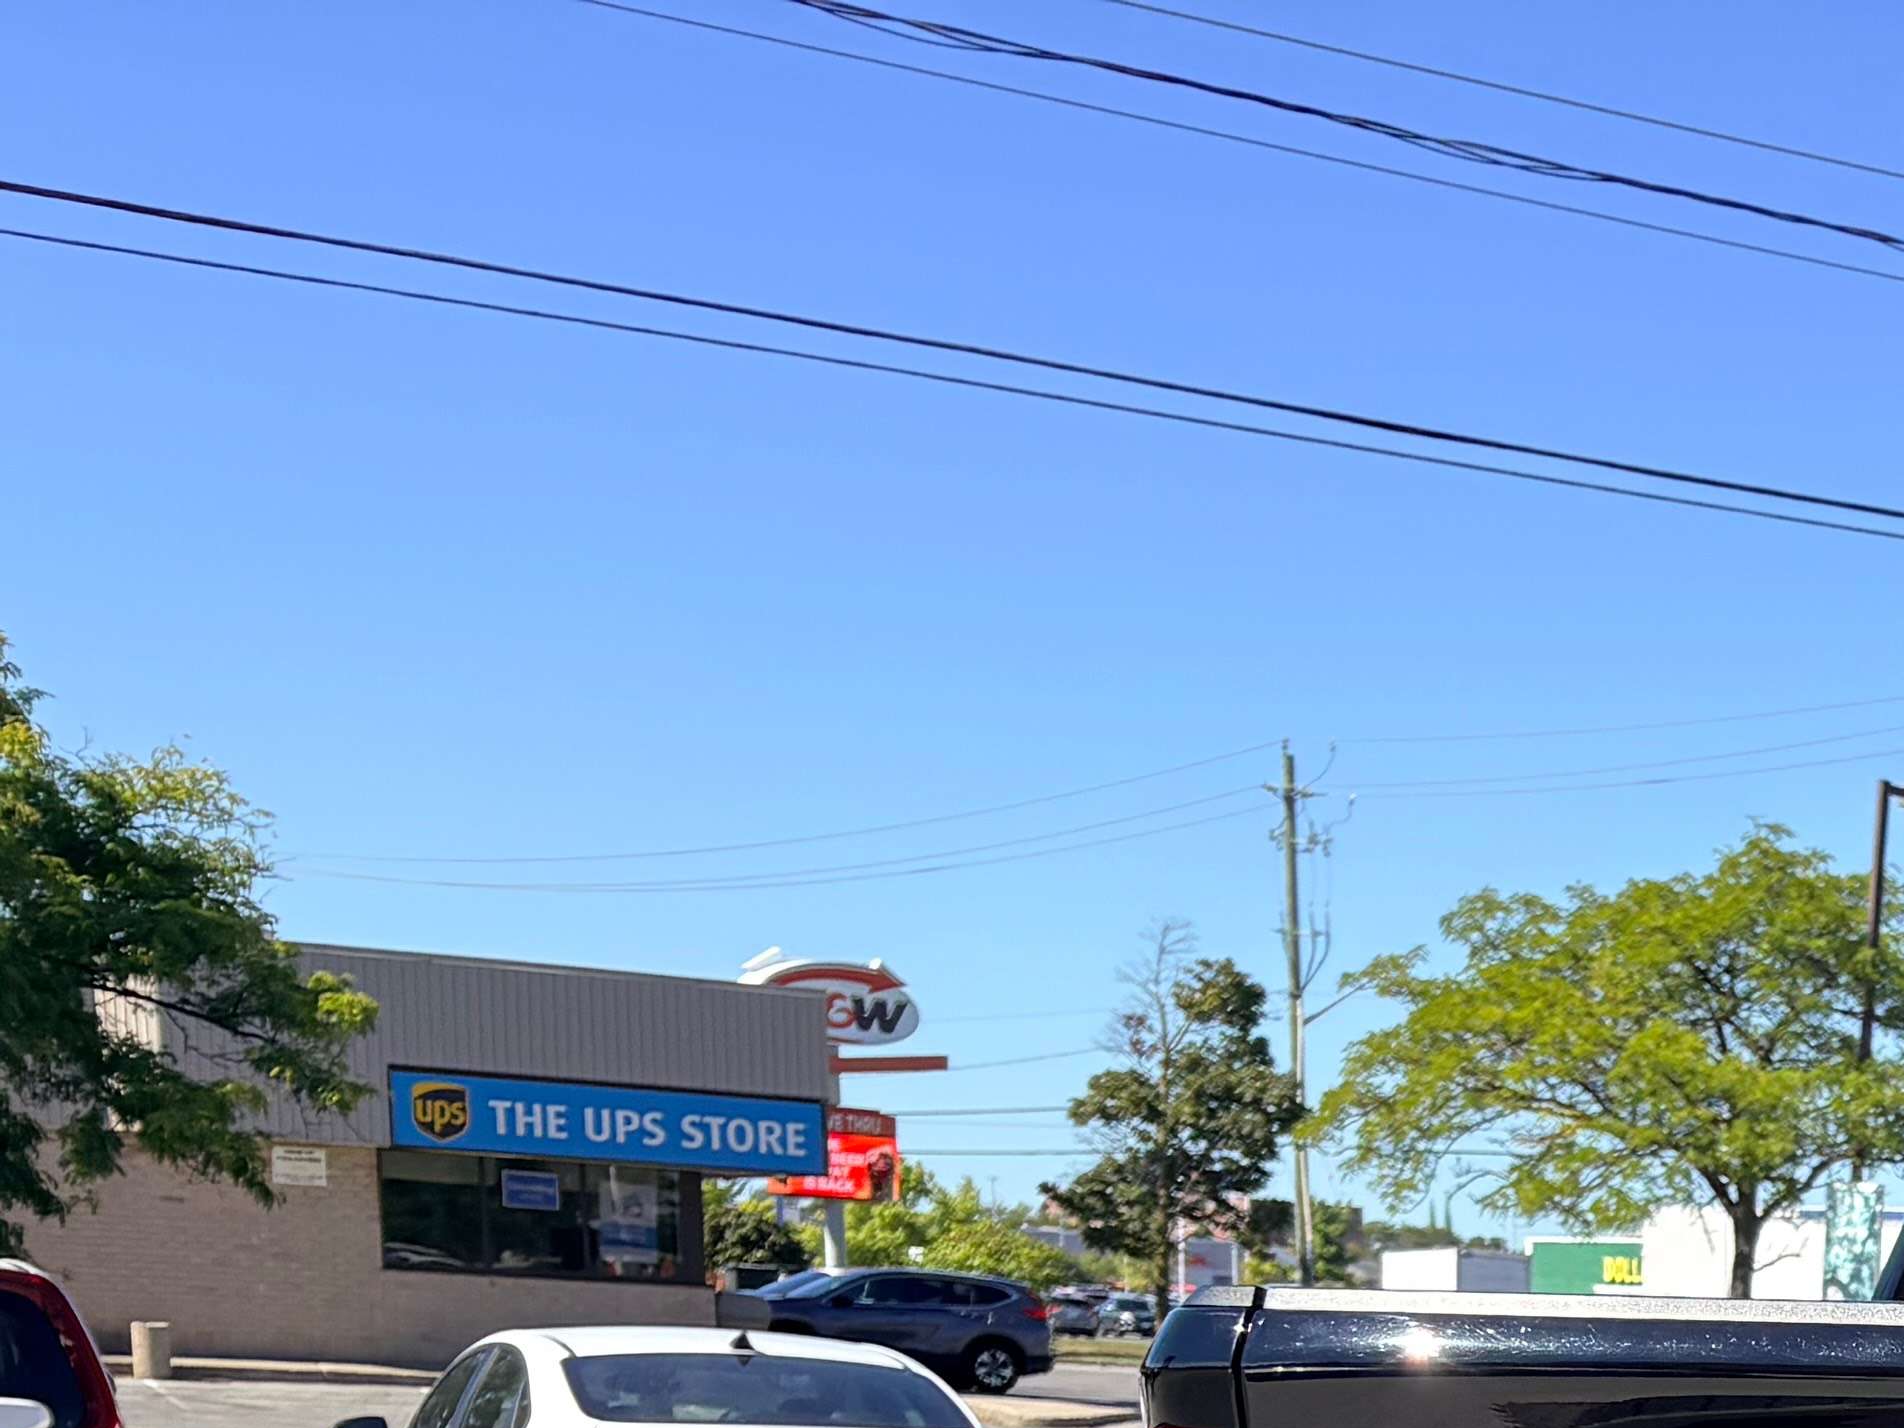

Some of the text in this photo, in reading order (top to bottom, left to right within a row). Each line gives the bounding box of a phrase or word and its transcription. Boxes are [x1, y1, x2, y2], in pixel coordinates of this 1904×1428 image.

[826, 992, 907, 1034] &W
[488, 1100, 569, 1140] THE
[584, 1107, 667, 1147] UPS
[680, 1114, 808, 1157] STORE
